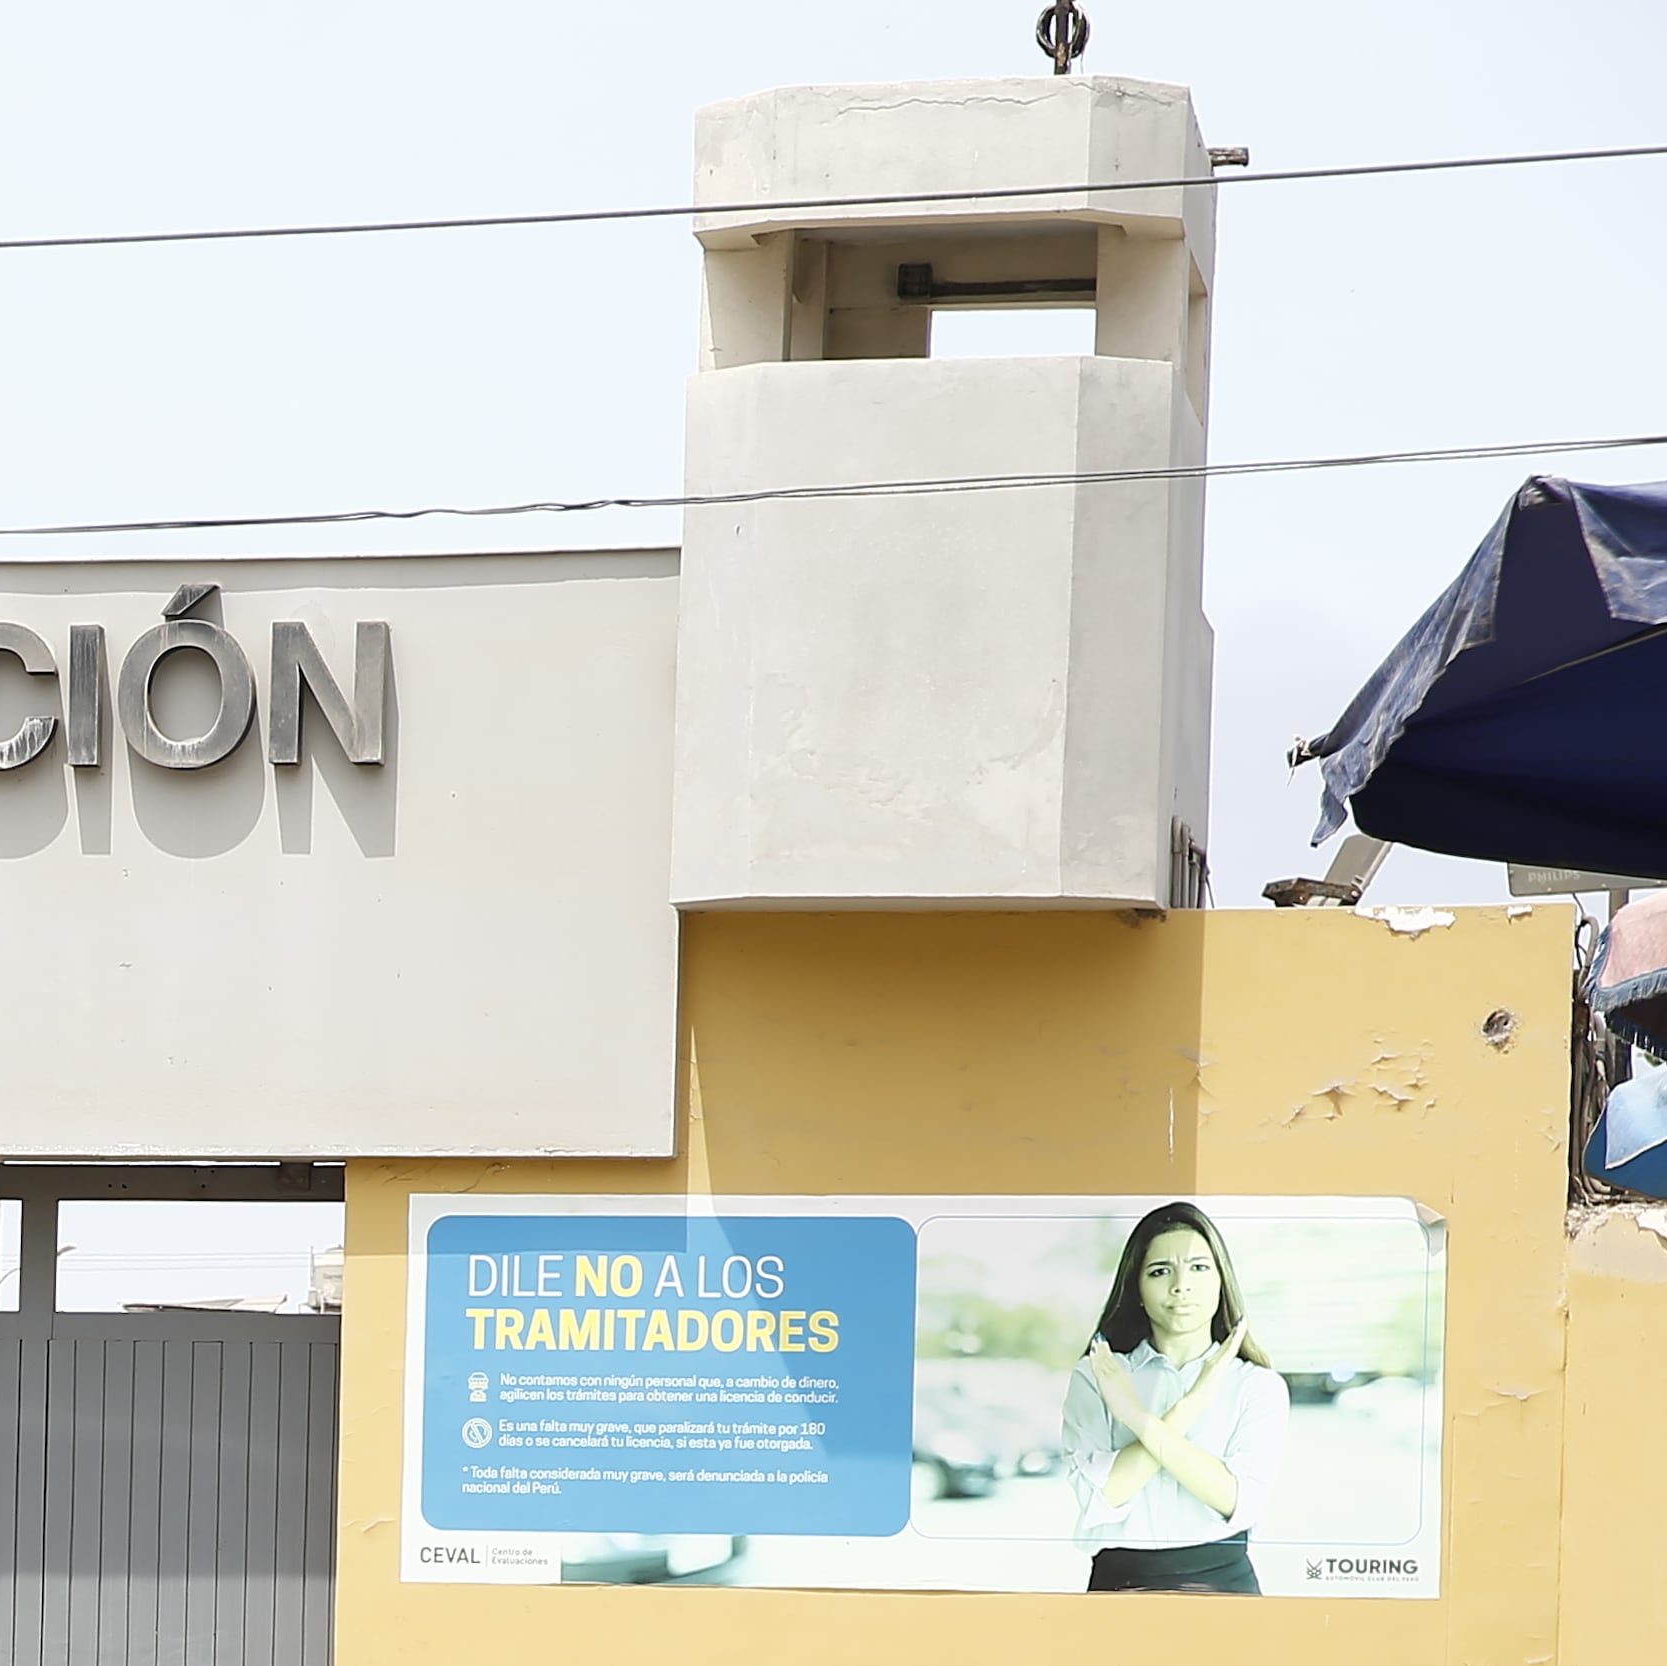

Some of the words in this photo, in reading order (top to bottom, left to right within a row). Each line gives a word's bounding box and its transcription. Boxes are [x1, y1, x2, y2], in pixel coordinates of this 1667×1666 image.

[1528, 871, 1580, 882] PHILIPS
[468, 1255, 563, 1297] DILE
[575, 1256, 643, 1297] NO
[654, 1256, 684, 1298] A
[698, 1256, 785, 1298] LOS
[466, 1309, 840, 1353] TRAMITADORES
[501, 1374, 515, 1385] No
[519, 1375, 577, 1386] contamos
[580, 1377, 602, 1386] con
[605, 1375, 643, 1389] ningún
[646, 1375, 696, 1391] personal
[736, 1376, 779, 1388] cambio
[782, 1376, 796, 1388] de
[500, 1388, 545, 1403] agilicen
[547, 1388, 564, 1400] los
[566, 1388, 617, 1401] trámites
[619, 1392, 644, 1404] para
[647, 1389, 693, 1402] obtener
[696, 1393, 717, 1402] una
[720, 1390, 765, 1403] licencia
[767, 1390, 783, 1403] de
[499, 1419, 514, 1432] Es
[516, 1422, 537, 1432] una
[540, 1420, 567, 1432] falta
[569, 1423, 595, 1437] muy
[634, 1424, 657, 1435] que
[659, 1421, 715, 1438] paralizará
[717, 1423, 730, 1434] tu
[733, 1422, 776, 1435] trámite
[779, 1425, 799, 1437] por
[800, 1423, 825, 1435] 180
[535, 1438, 550, 1446] se
[552, 1435, 609, 1447] cancelará
[611, 1437, 624, 1447] tu
[676, 1436, 687, 1448] si
[689, 1438, 716, 1448] esta
[718, 1440, 732, 1451] ya
[735, 1437, 755, 1449] fue
[757, 1438, 813, 1452] otorgada.
[471, 1467, 497, 1479] Toda
[501, 1467, 528, 1479] falta
[529, 1468, 600, 1480] considerada
[604, 1471, 628, 1483] muy
[697, 1470, 765, 1482] denunciada
[777, 1470, 787, 1482] la
[462, 1481, 510, 1493] nacional
[512, 1481, 530, 1494] del
[420, 1547, 481, 1564] CEVAL
[492, 1548, 521, 1556] Centro
[522, 1548, 533, 1556] de
[492, 1557, 548, 1565] Evaluaciones
[1326, 1559, 1418, 1574] TOURING
